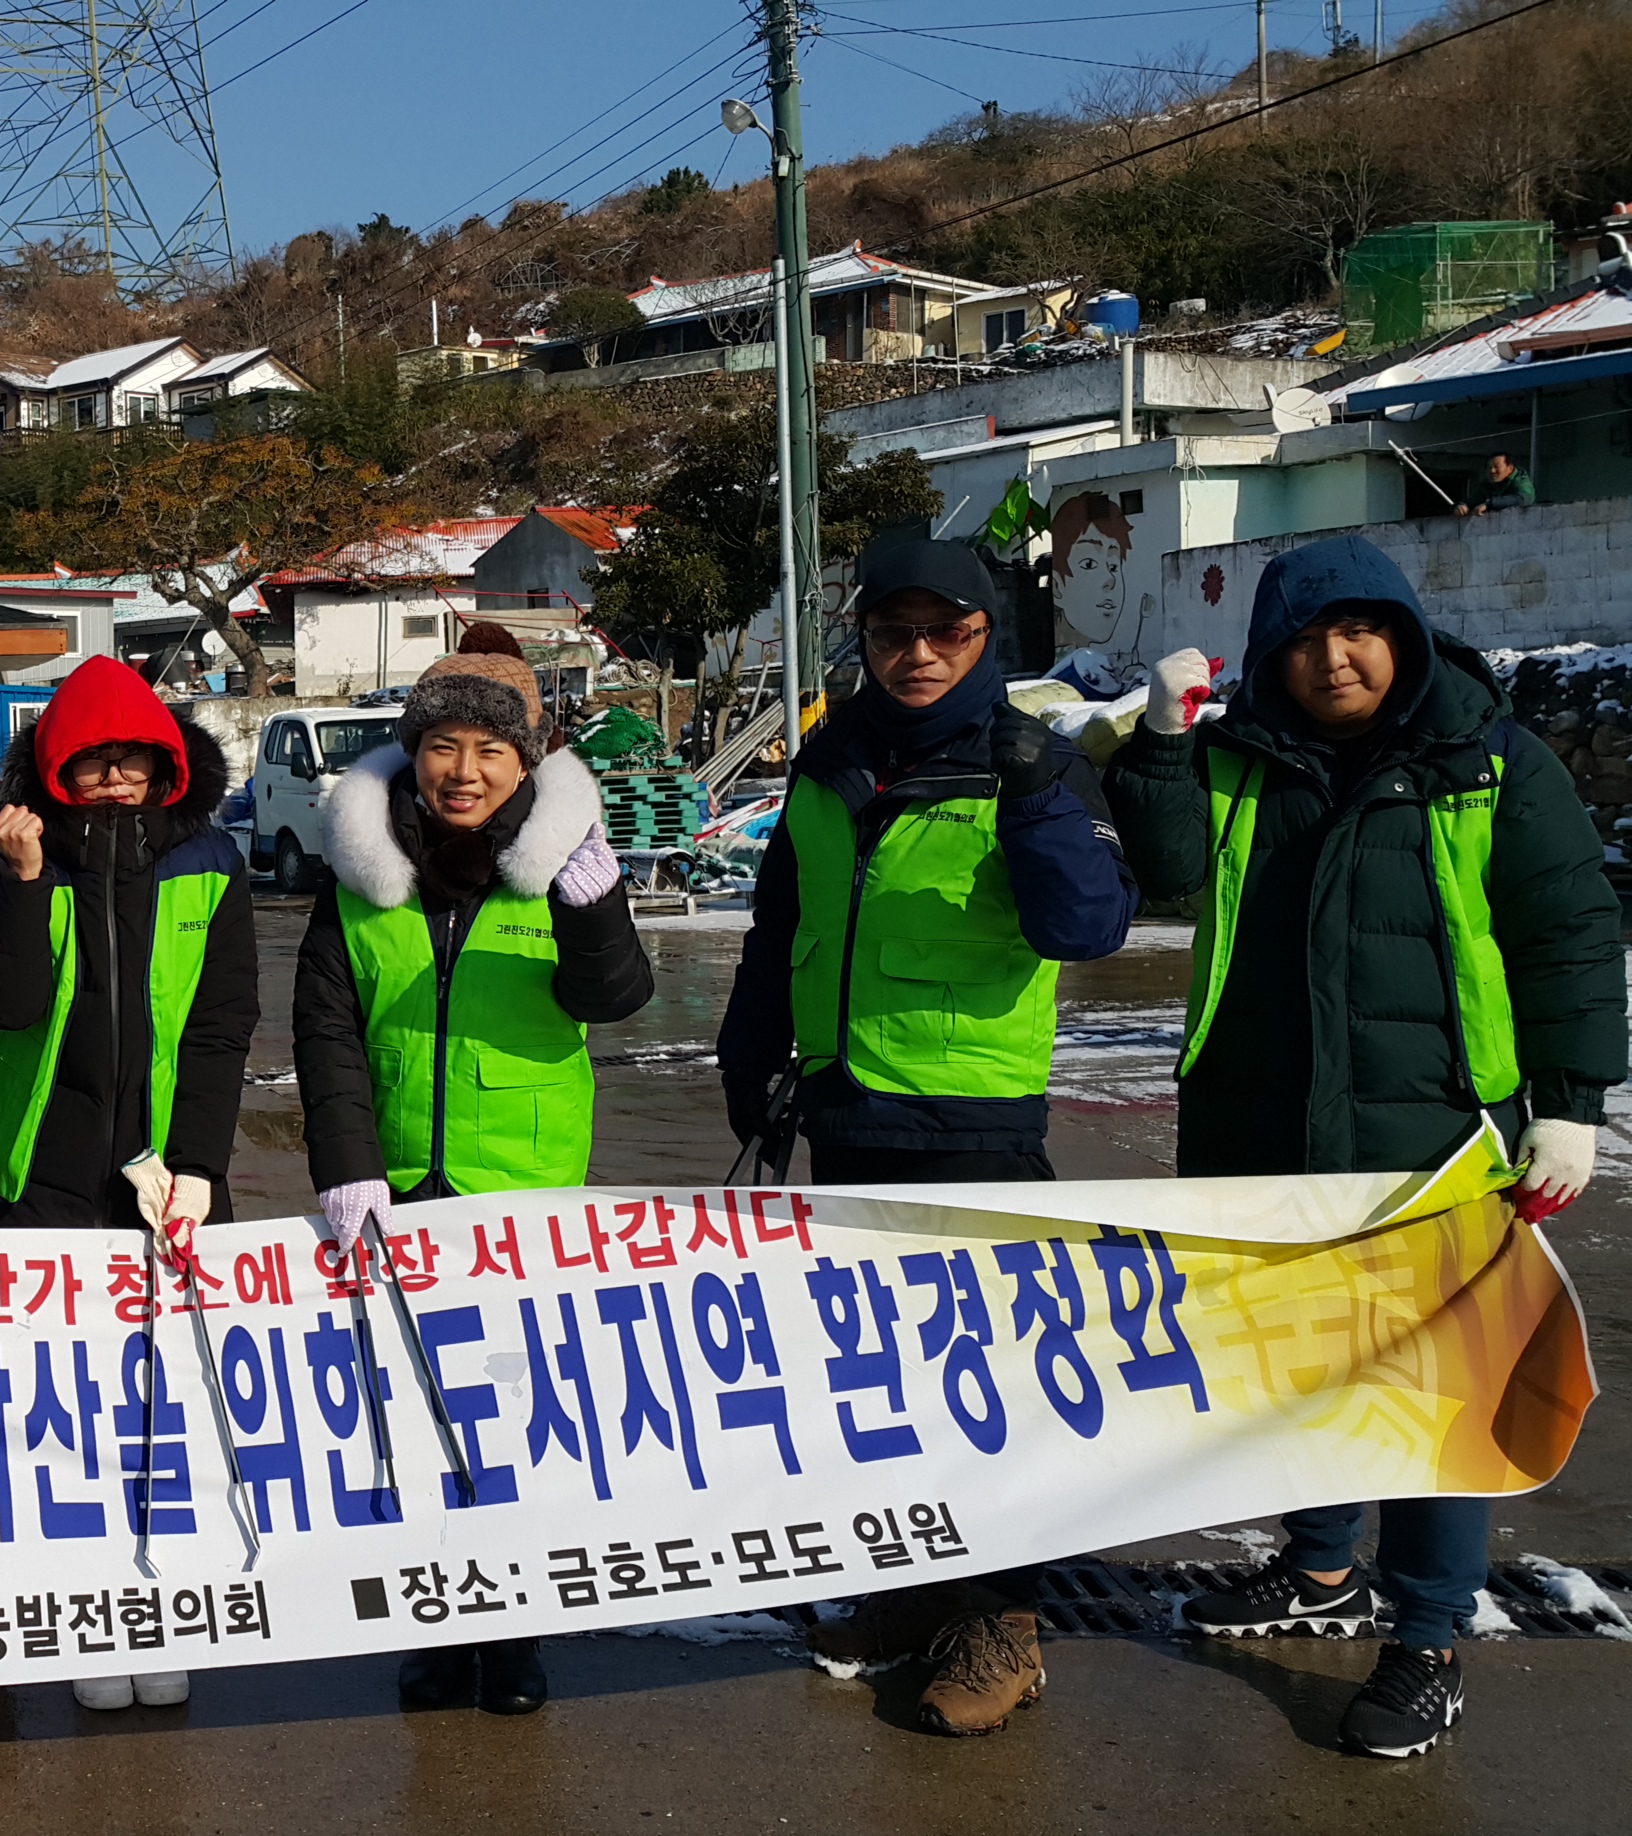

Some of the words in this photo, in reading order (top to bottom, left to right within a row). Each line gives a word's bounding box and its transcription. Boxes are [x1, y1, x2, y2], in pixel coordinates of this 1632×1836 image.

[106, 1243, 293, 1324] 청소에
[314, 1228, 441, 1300] 앞장
[546, 1190, 814, 1274] 나갑시다
[221, 1311, 404, 1534] 위한
[416, 1271, 803, 1510] 도서지역
[804, 1223, 1210, 1464] 환경정화
[399, 1559, 528, 1625] 장소:
[853, 1501, 970, 1570] 일원
